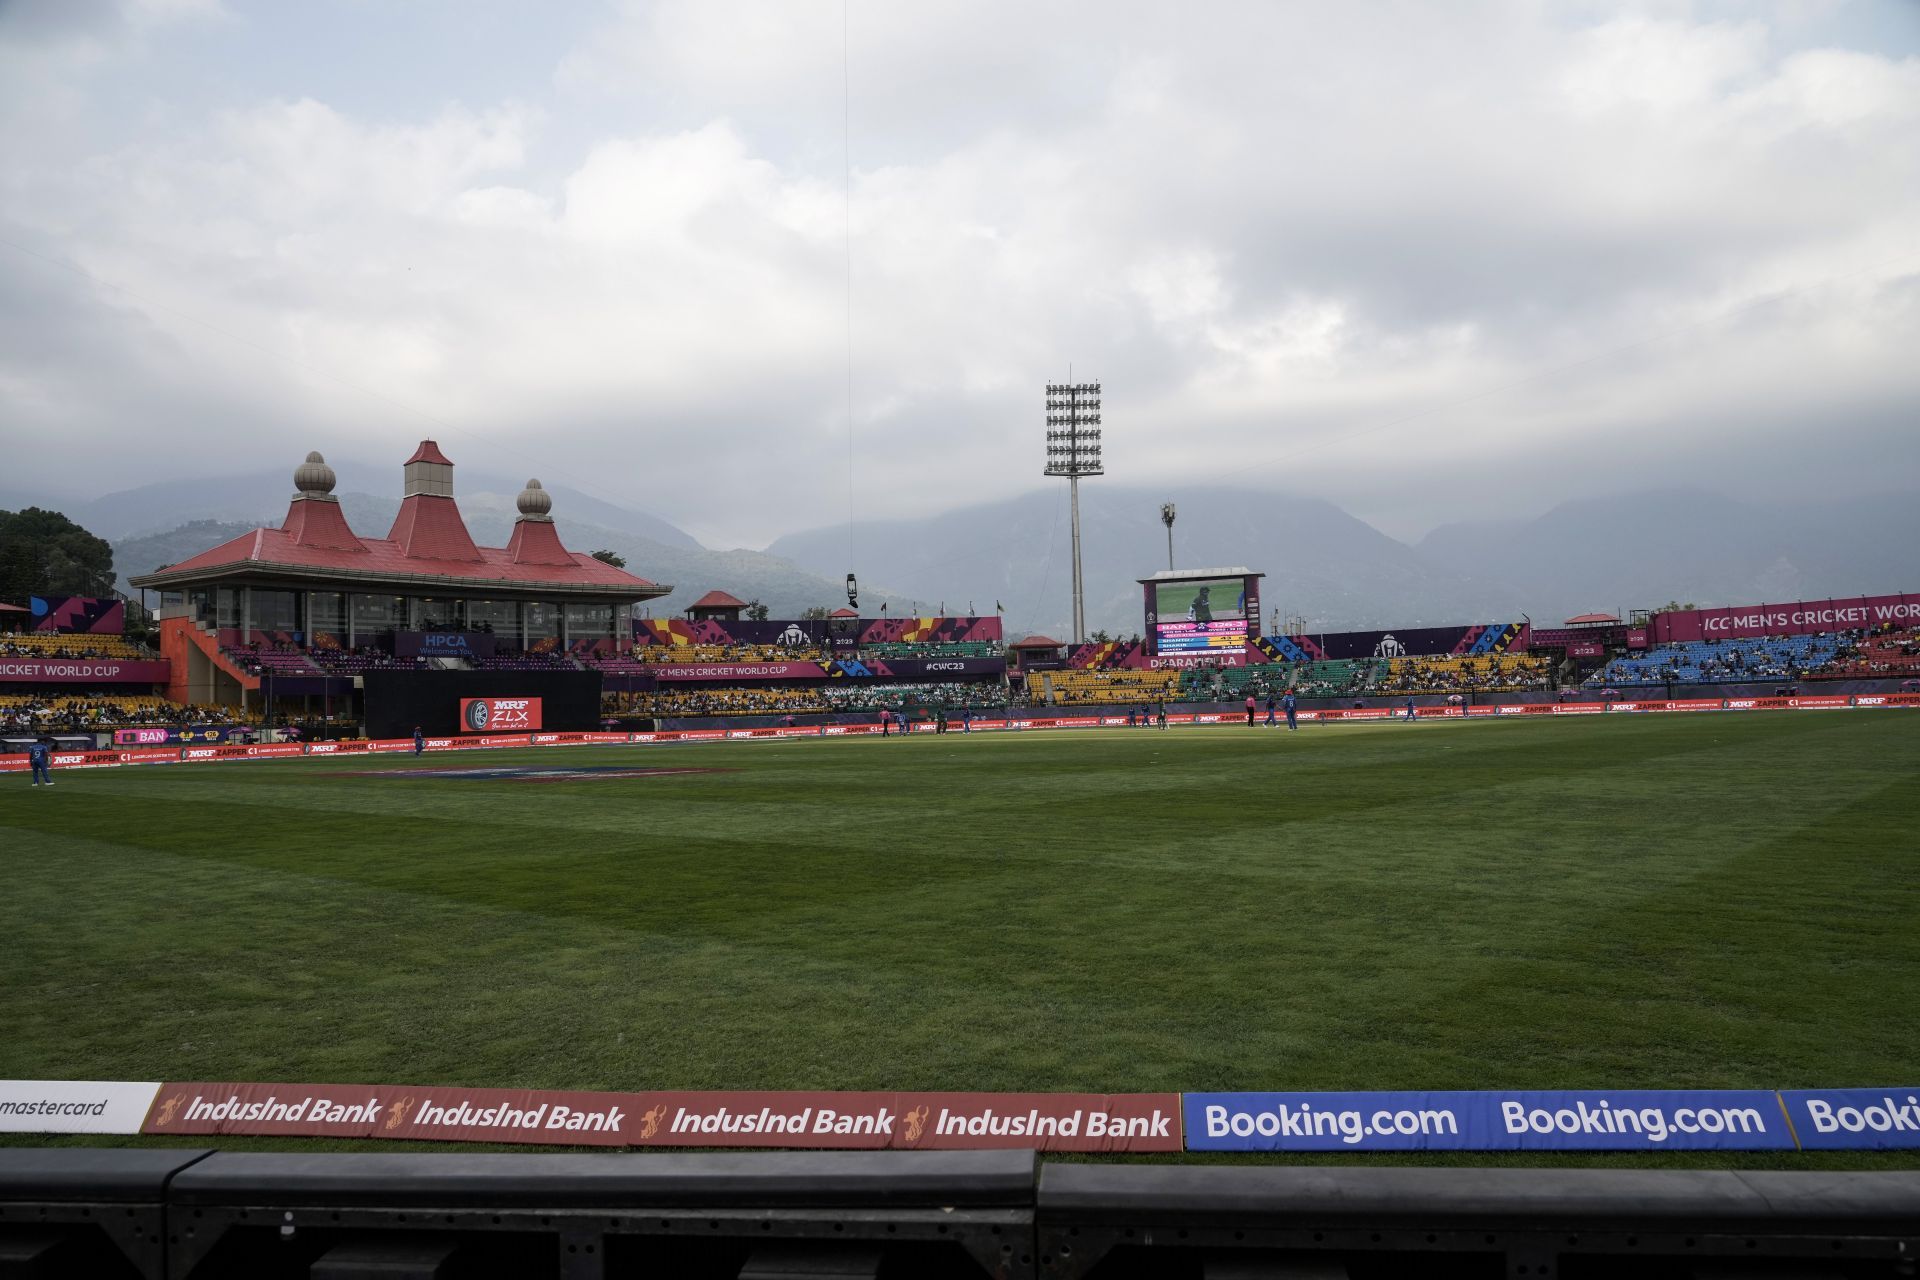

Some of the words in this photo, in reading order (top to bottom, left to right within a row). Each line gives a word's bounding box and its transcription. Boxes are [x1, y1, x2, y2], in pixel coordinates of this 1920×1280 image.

[1704, 617, 1730, 630] ICC
[1734, 613, 1788, 629] MEN'S
[1792, 606, 1870, 625] CRICKET
[426, 634, 466, 646] HPCA
[44, 666, 92, 676] WORLD
[94, 666, 120, 676] CUP
[668, 668, 694, 676] MEN'S
[696, 668, 733, 676] CRICKET
[735, 666, 768, 674] WORLD
[926, 662, 965, 670] #CWC23
[494, 700, 528, 710] MRF
[492, 711, 528, 721] ZLX
[140, 732, 164, 742] BAN
[54, 756, 84, 764] MRF
[85, 754, 120, 762] ZAPPER
[120, 754, 131, 762] C1
[0, 1100, 107, 1116] mastercard
[184, 1095, 311, 1121] IndusInd
[313, 1098, 383, 1123] Bank
[414, 1100, 548, 1128] IndusInd
[545, 1104, 626, 1132] Bank
[670, 1108, 811, 1134] IndusInd
[813, 1109, 895, 1135] Bank
[936, 1109, 1082, 1136] IndusInd
[1086, 1110, 1170, 1137] Bank
[1502, 1100, 1765, 1141] Booking.com
[1206, 1103, 1457, 1144] Booking.com
